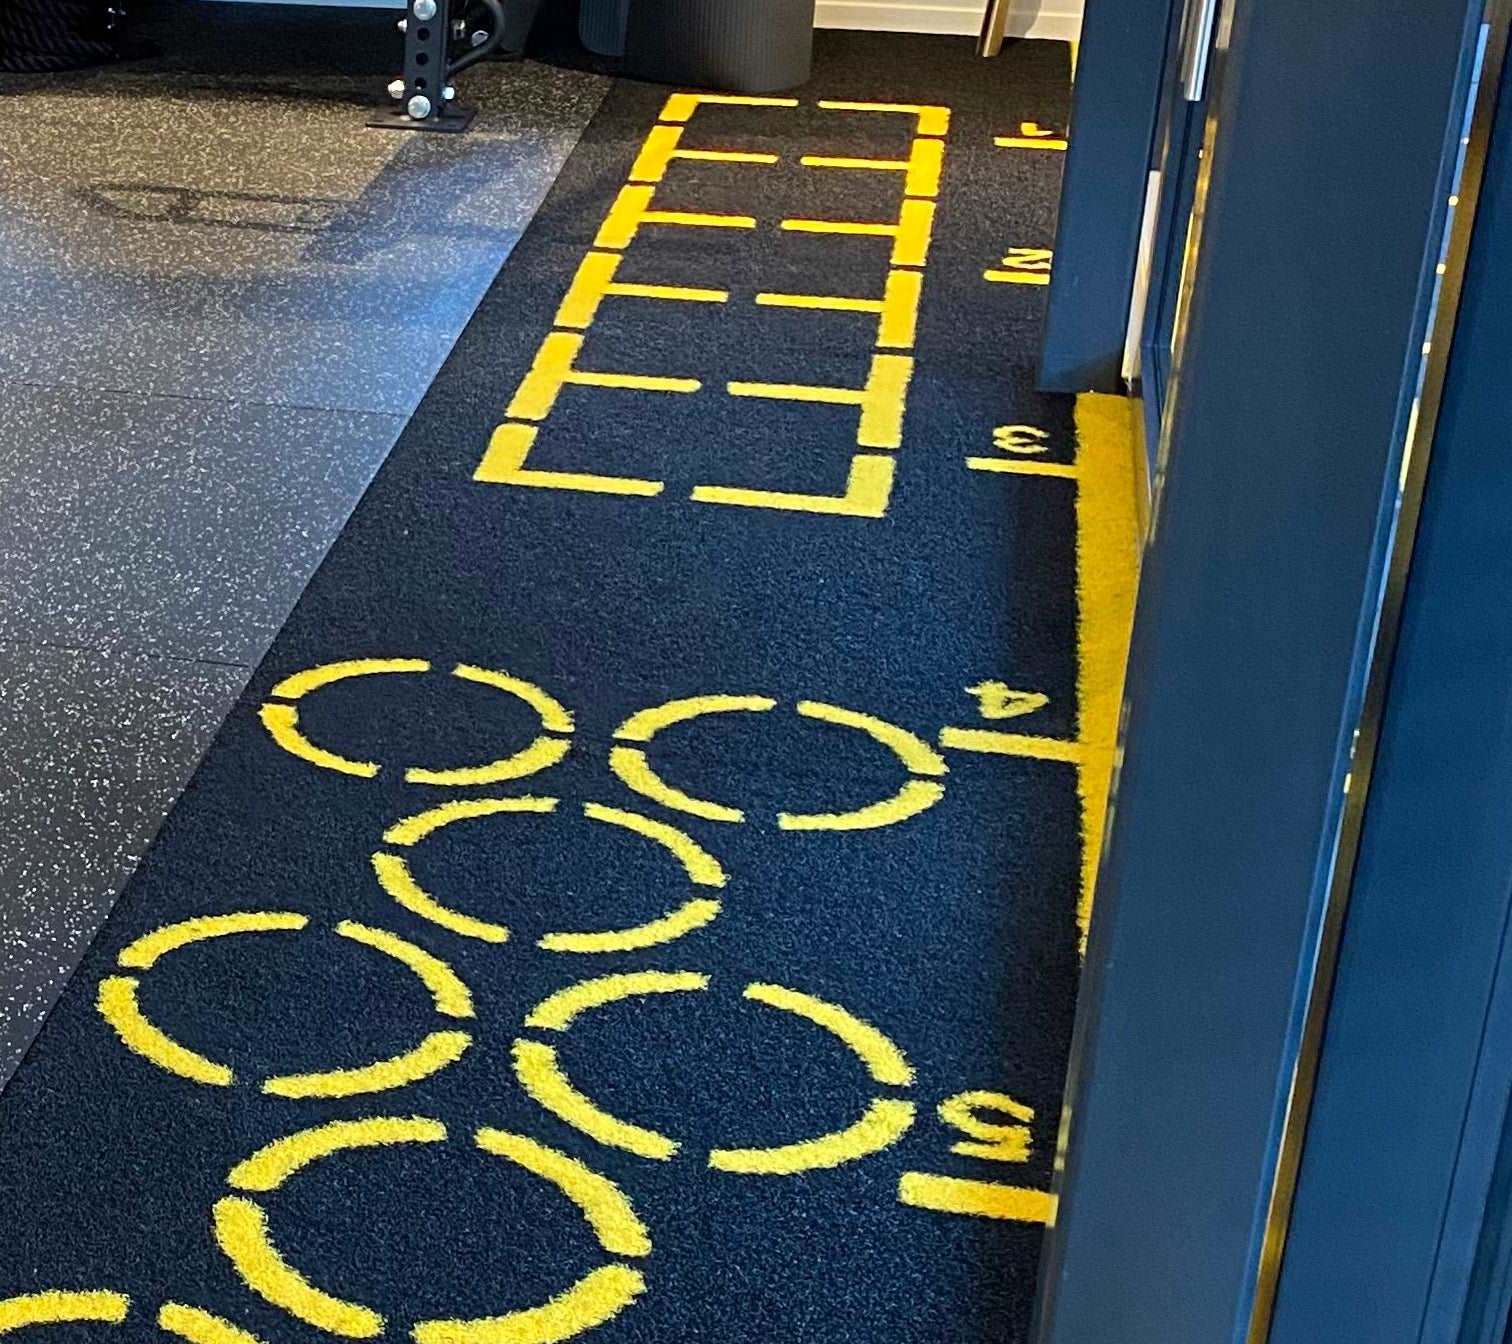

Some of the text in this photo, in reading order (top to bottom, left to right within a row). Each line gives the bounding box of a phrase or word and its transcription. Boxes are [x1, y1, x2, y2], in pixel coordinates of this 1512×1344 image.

[992, 424, 1050, 454] 3
[965, 680, 1050, 720] 4
[937, 1089, 1036, 1163] 5
